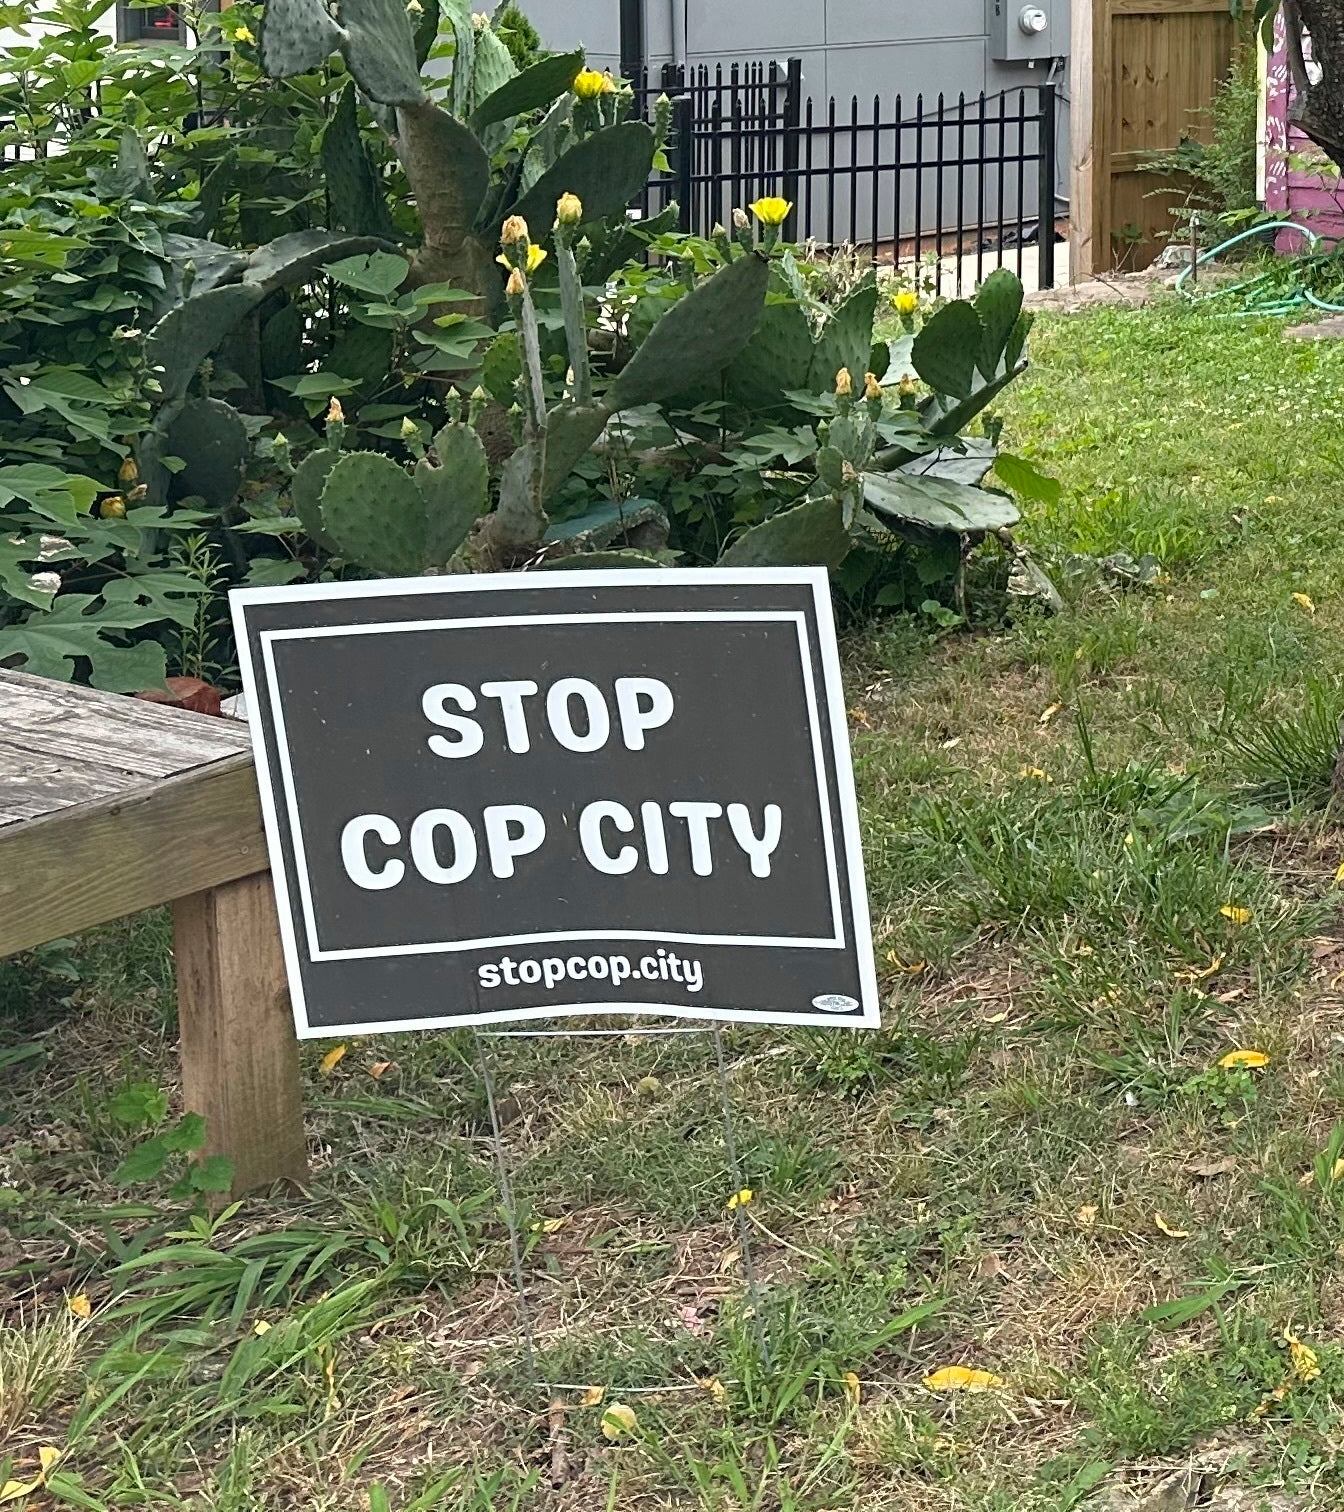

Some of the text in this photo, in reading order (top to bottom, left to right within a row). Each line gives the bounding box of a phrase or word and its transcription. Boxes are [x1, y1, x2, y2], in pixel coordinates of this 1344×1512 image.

[421, 676, 676, 759] STOP
[340, 799, 783, 890] COP CITY
[478, 947, 703, 992] stopcop.city
